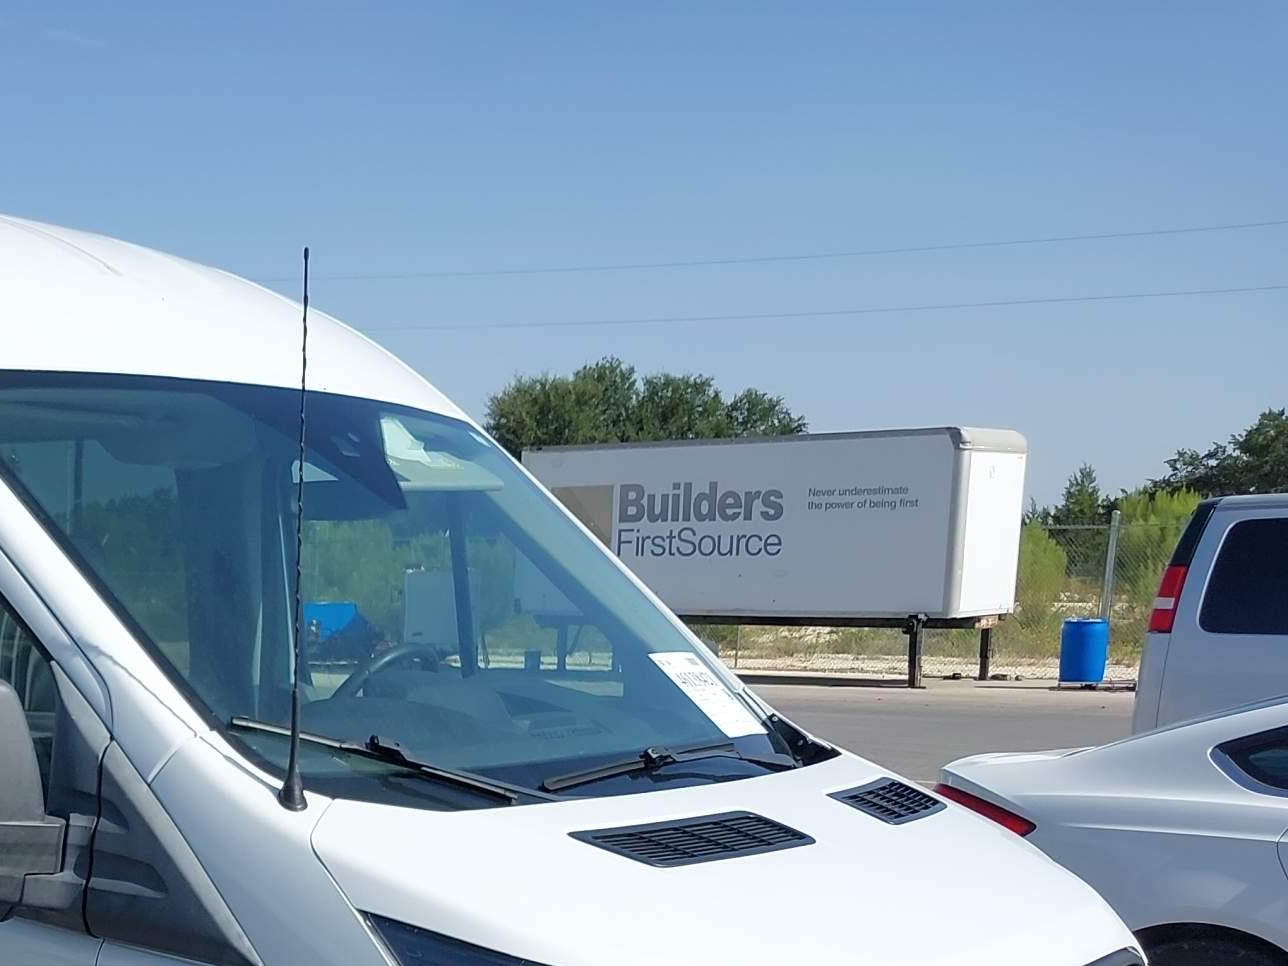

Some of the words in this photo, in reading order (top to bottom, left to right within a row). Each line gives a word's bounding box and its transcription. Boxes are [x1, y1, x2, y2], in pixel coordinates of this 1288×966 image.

[618, 481, 784, 524] Builders
[808, 487, 837, 498] Never
[838, 485, 909, 497] underestimate
[807, 500, 823, 511] the
[825, 501, 855, 513] power
[857, 499, 867, 510] of
[869, 498, 897, 512] being
[899, 497, 920, 509] first
[616, 527, 783, 557] FirstSource
